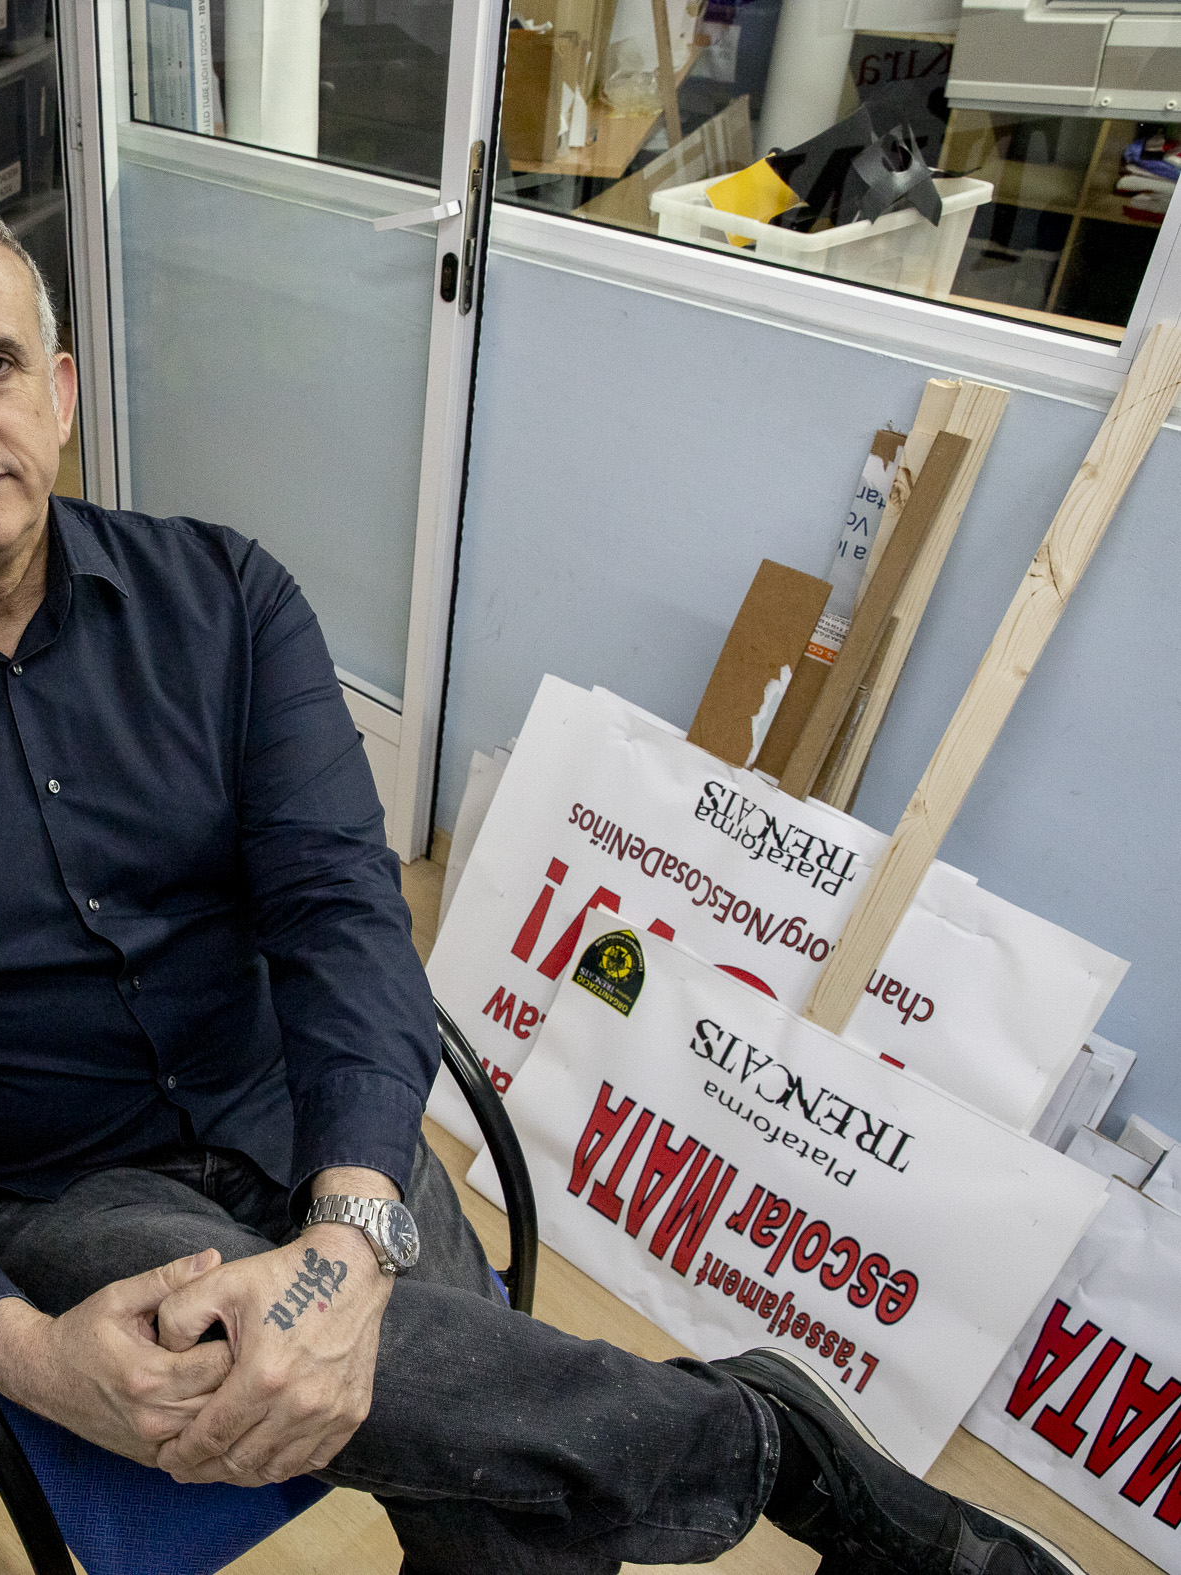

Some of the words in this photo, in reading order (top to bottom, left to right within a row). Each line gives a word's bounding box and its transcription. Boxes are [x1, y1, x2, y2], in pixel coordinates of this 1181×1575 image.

[694, 796, 844, 897] Plataforma
[703, 780, 860, 882] TRENCATS
[482, 985, 547, 1040] aw
[689, 1018, 916, 1174] TRENCATS
[703, 1079, 857, 1188] Plataforma
[567, 1079, 738, 1278] MATA
[694, 1251, 879, 1394] L'assetjament
[725, 1183, 919, 1326] escolar
[1004, 1297, 1181, 1531] MATA
